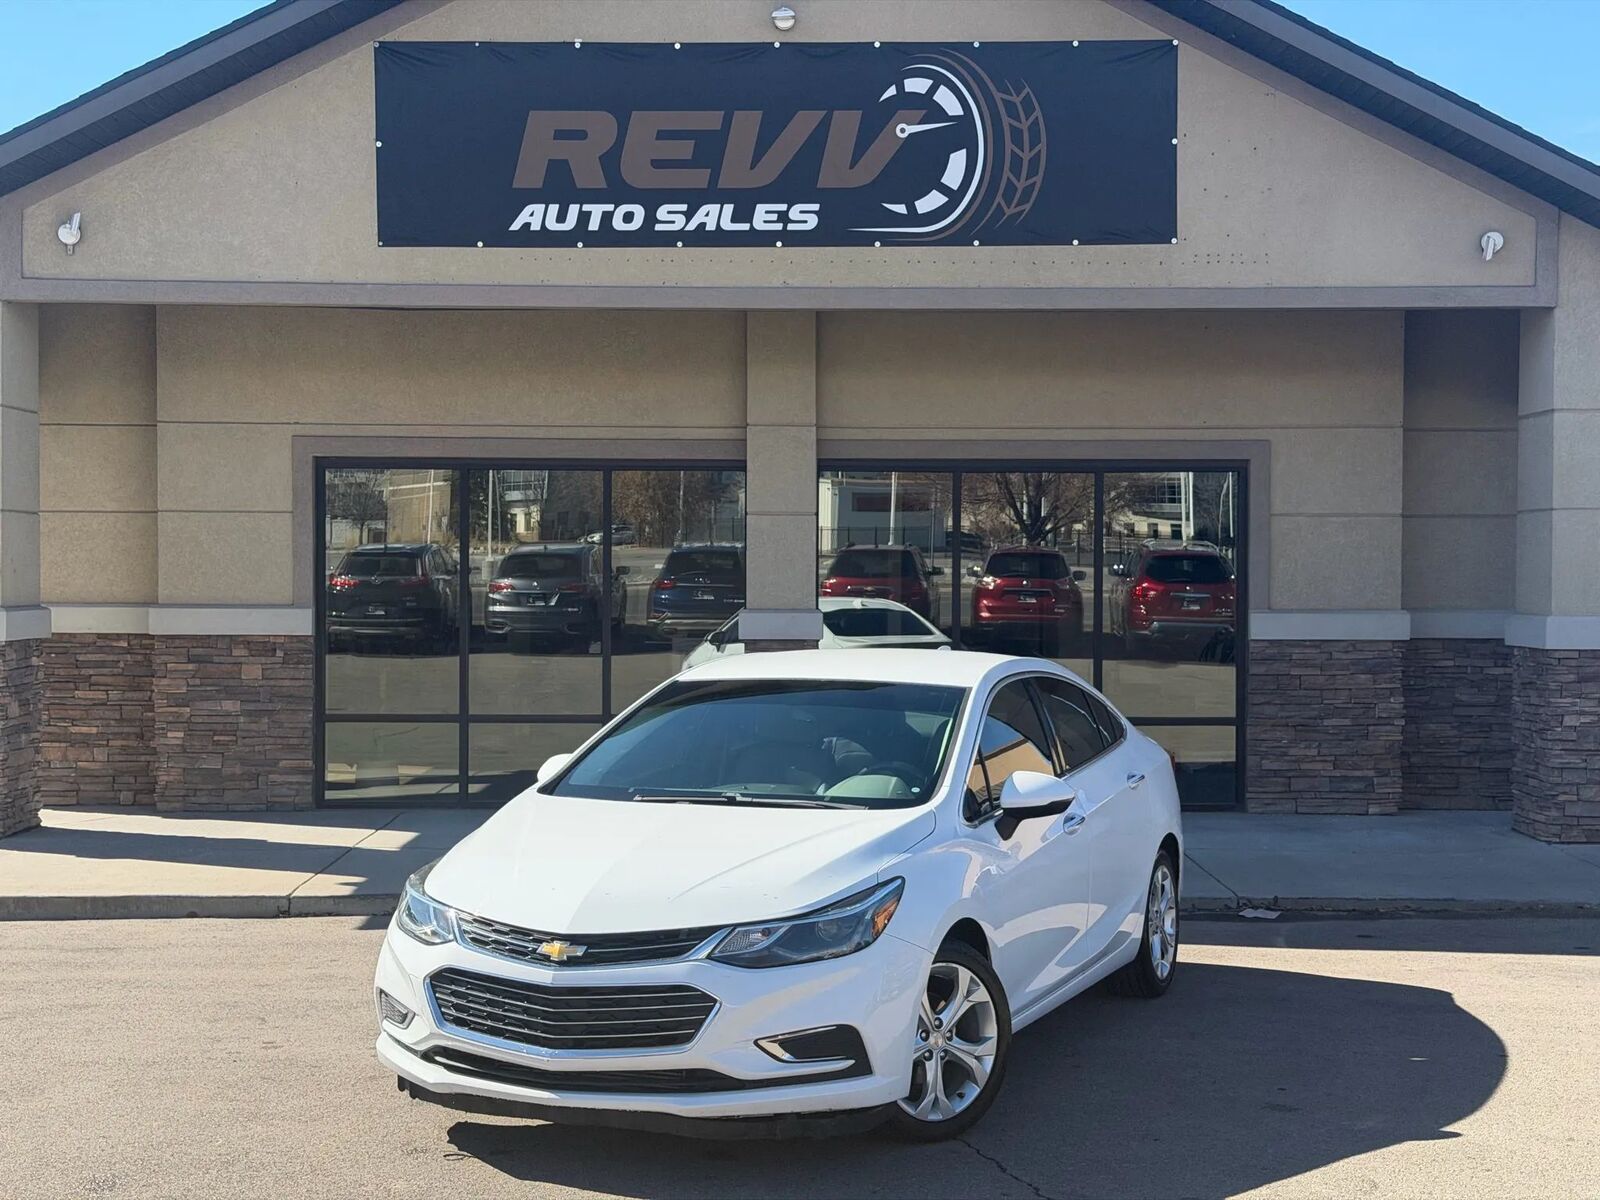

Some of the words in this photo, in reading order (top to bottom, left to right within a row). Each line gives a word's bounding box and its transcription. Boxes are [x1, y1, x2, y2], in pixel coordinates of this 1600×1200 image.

[512, 110, 926, 190] REVV
[508, 203, 644, 231] AUTO
[654, 203, 820, 231] SALES
